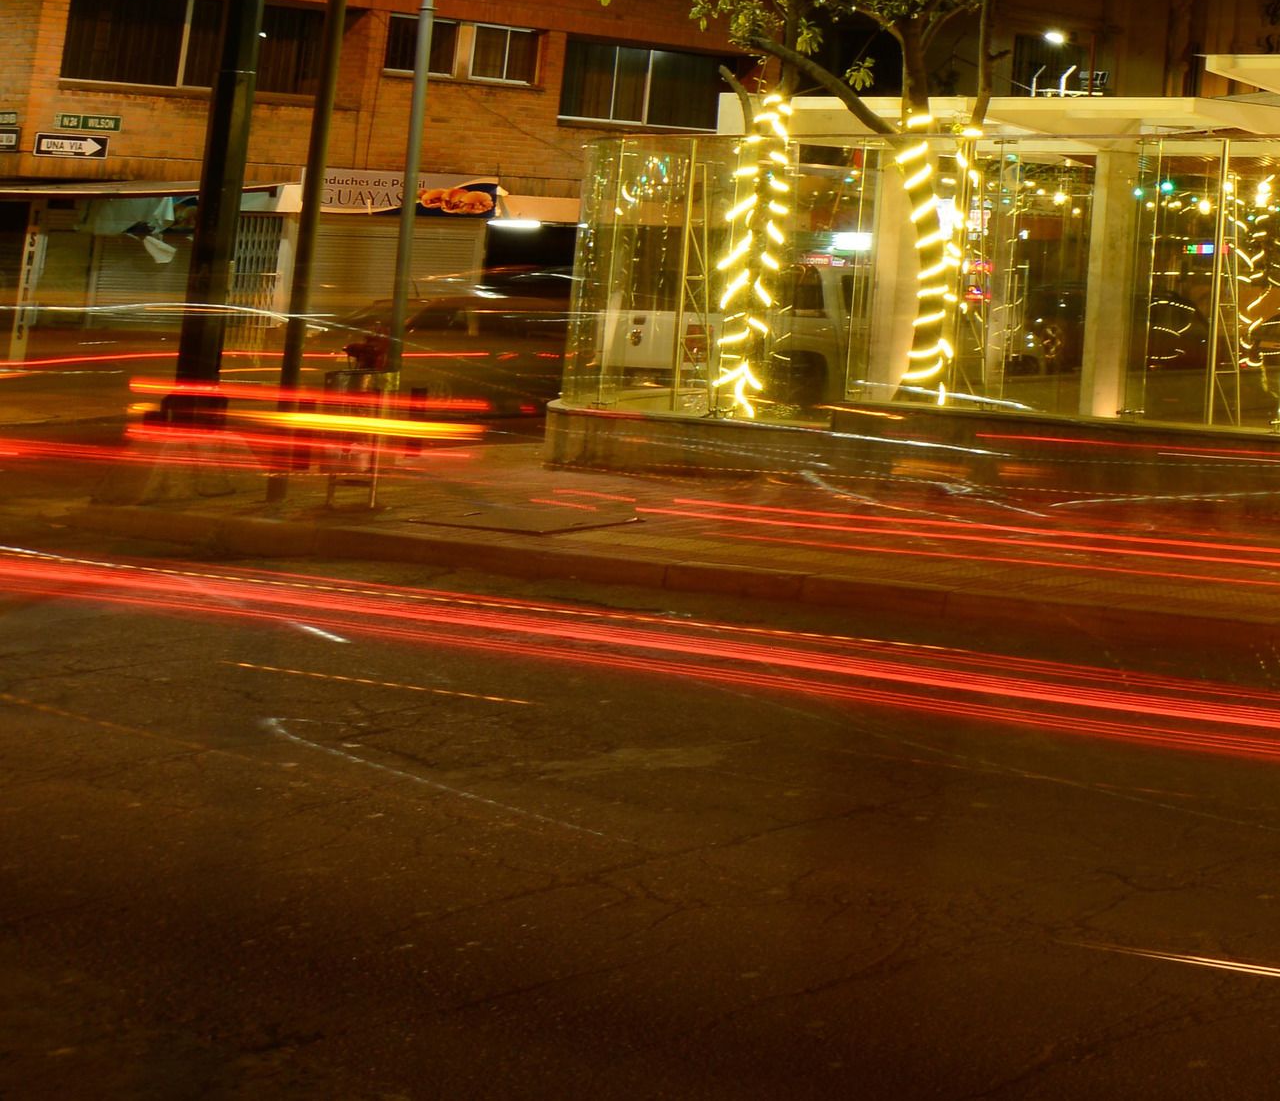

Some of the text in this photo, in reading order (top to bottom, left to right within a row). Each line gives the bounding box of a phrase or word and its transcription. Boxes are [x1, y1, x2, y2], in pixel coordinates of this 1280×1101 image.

[87, 118, 115, 129] WILSON
[46, 140, 83, 151] UNA VIA
[320, 176, 369, 187] nduches
[373, 178, 388, 187] de
[319, 188, 404, 208] GUAYAS
